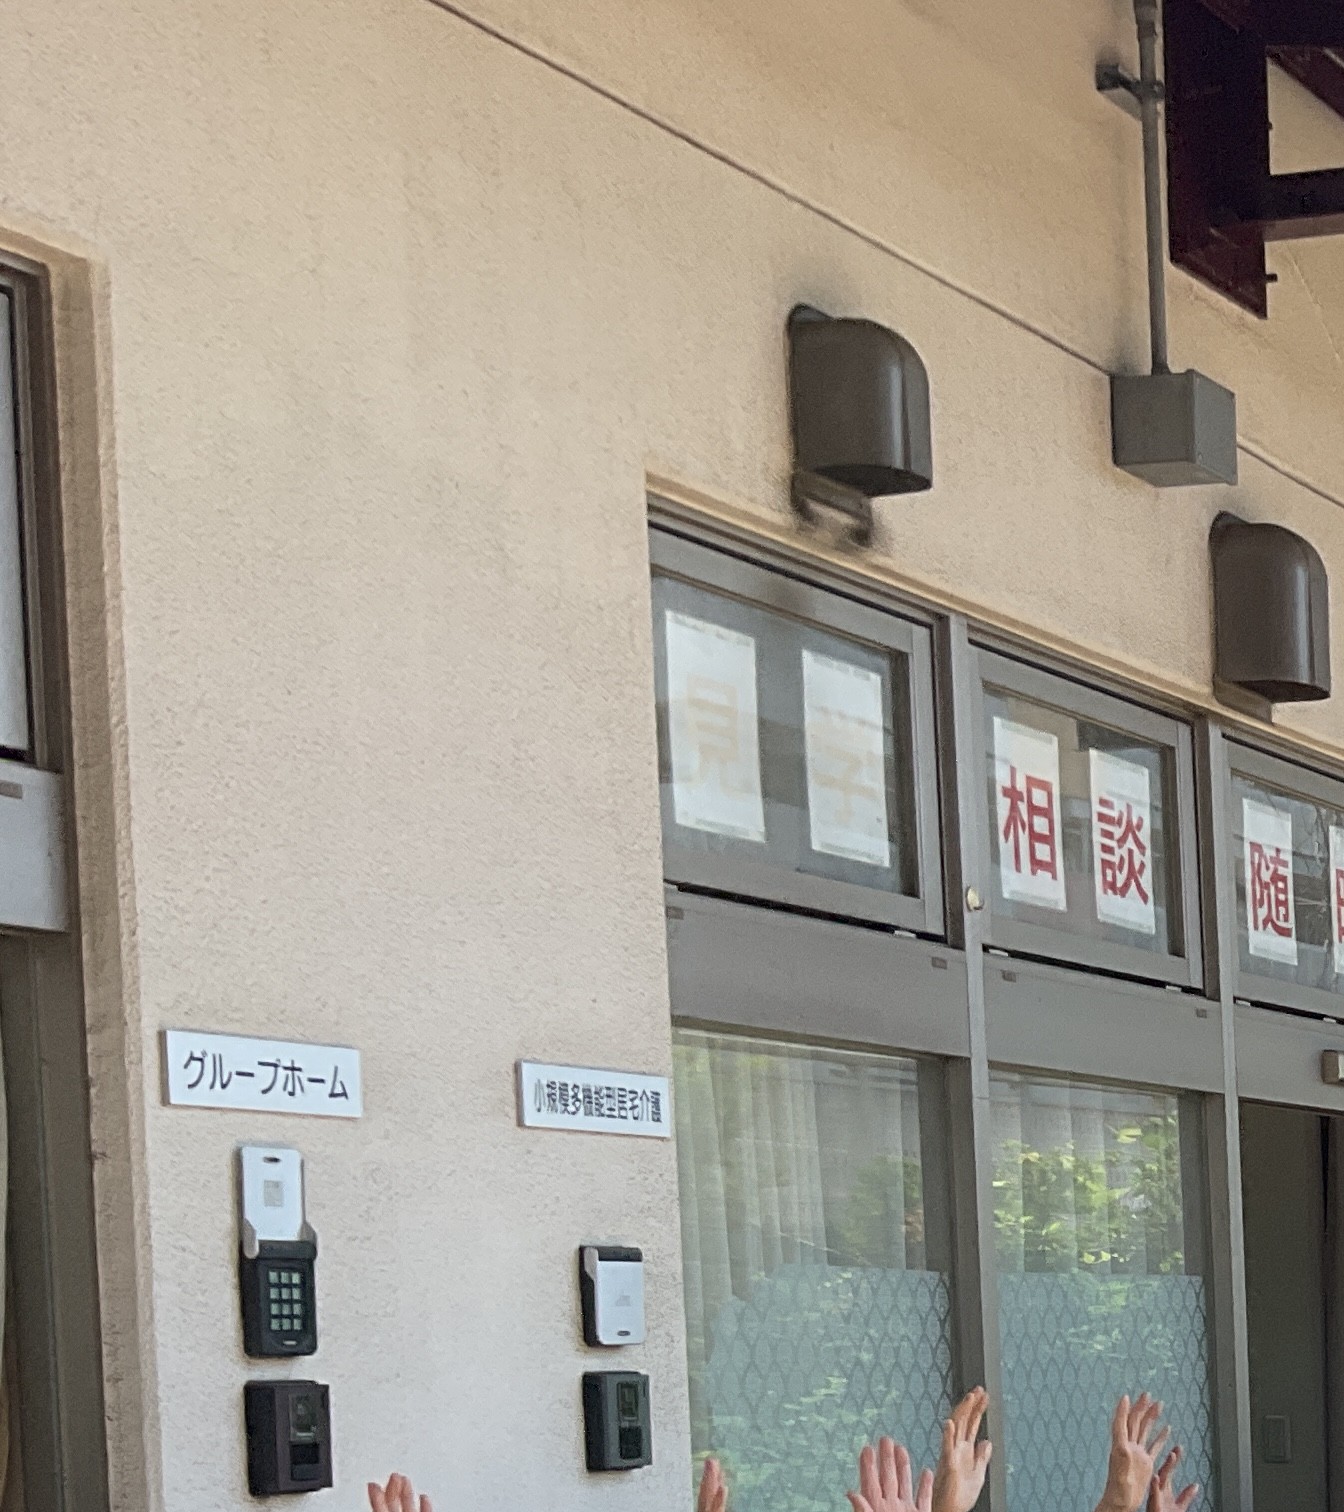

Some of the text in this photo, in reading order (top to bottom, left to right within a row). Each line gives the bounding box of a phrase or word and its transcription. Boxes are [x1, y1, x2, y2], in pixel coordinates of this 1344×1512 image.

[183, 1050, 349, 1100] グループホーム
